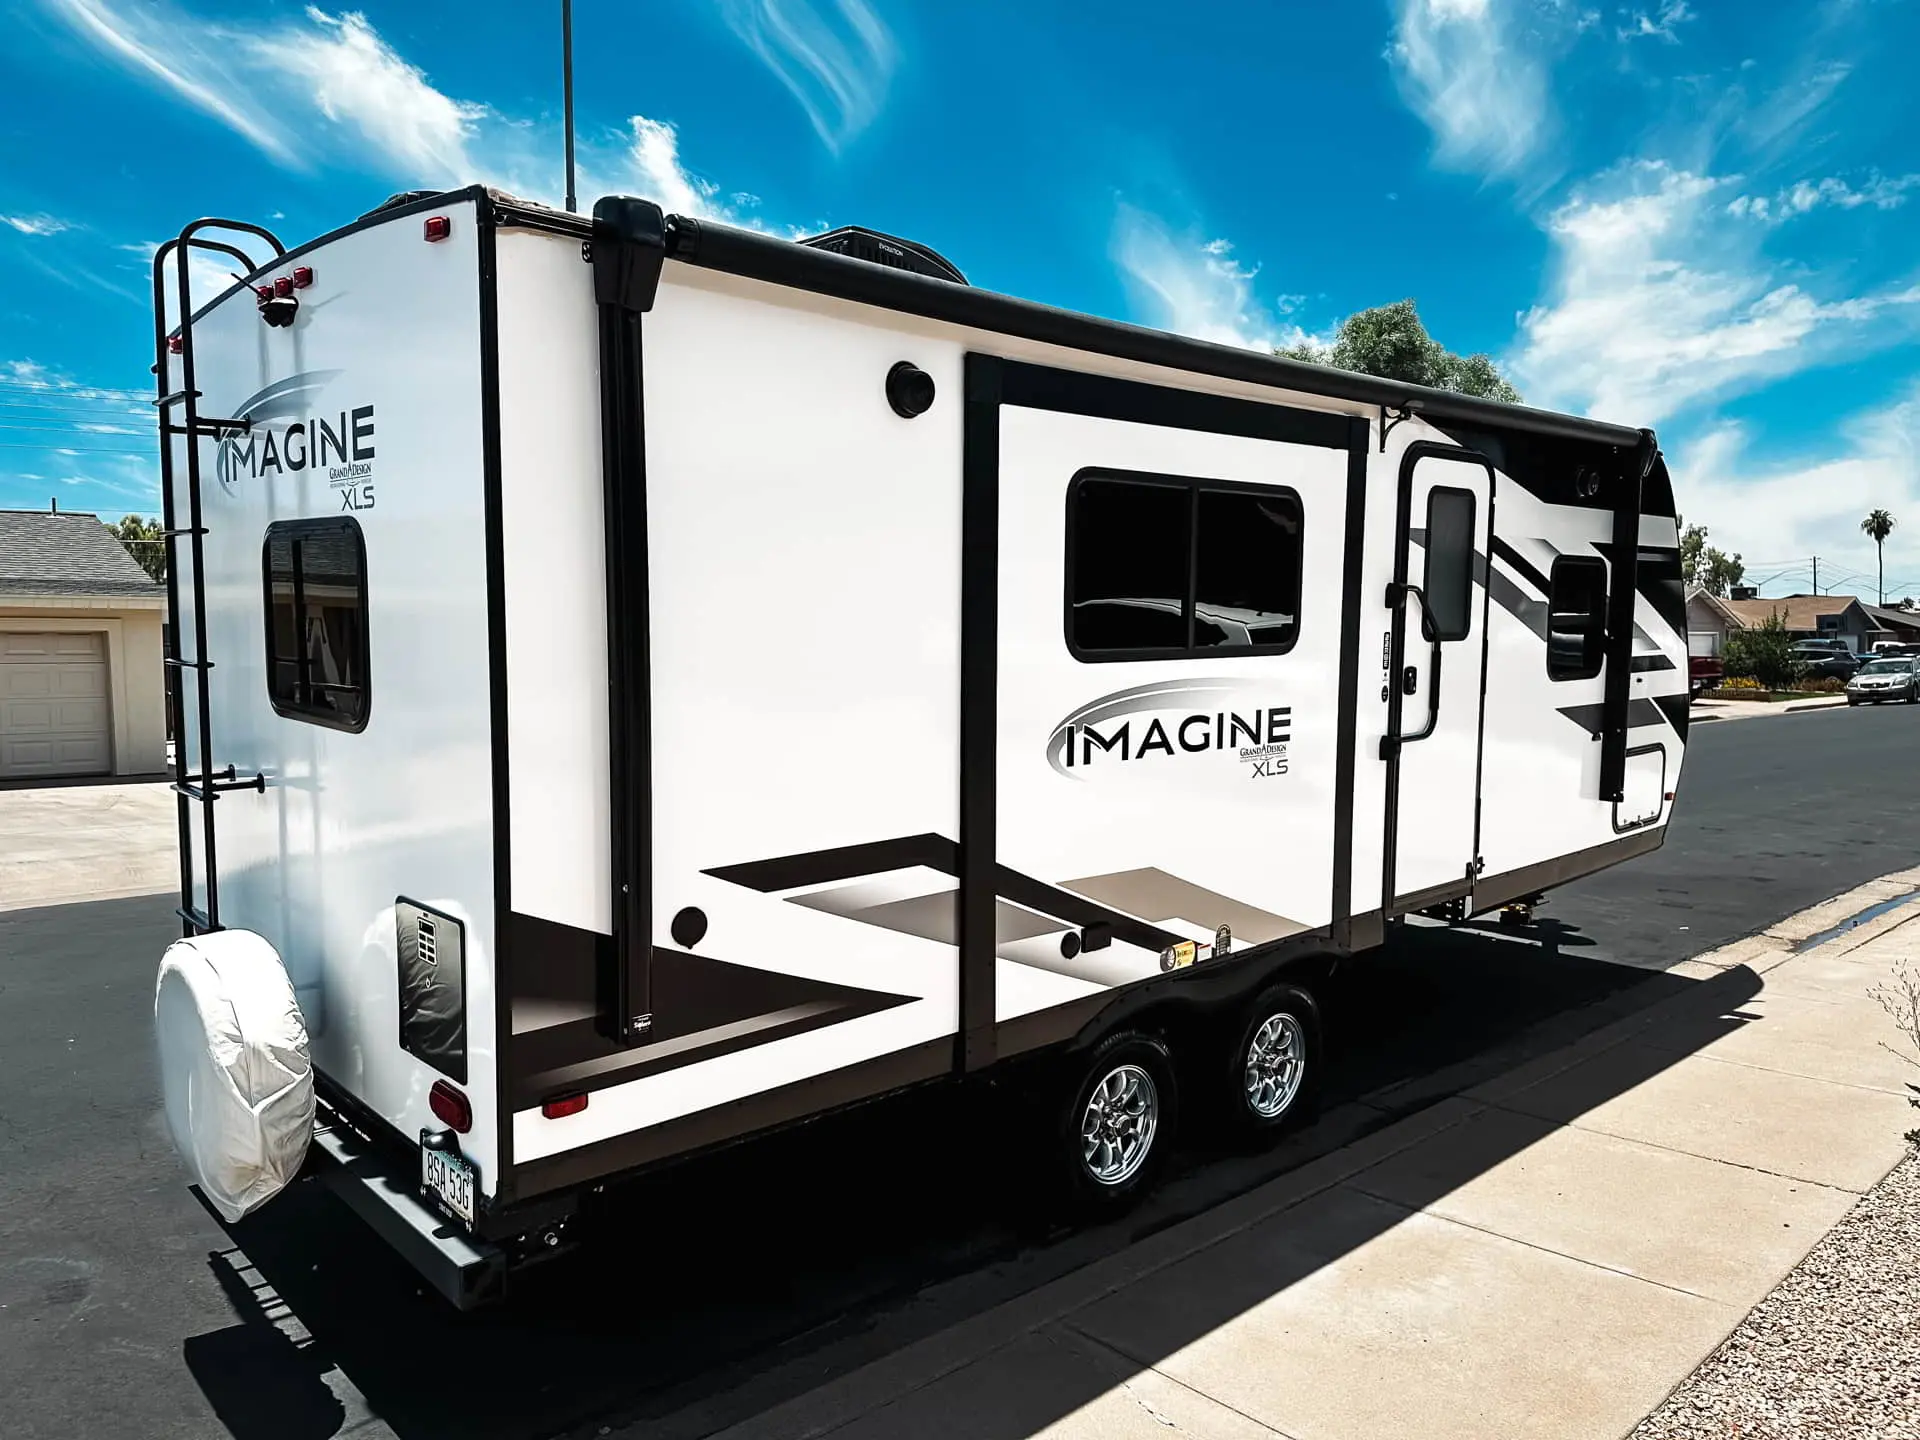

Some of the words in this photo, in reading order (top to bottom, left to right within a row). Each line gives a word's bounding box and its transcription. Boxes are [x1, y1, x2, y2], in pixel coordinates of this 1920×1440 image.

[224, 404, 375, 483] IMAGINE
[341, 486, 375, 511] XLS
[1066, 707, 1291, 767] IMAGINE
[1252, 759, 1289, 779] XLS
[427, 1151, 446, 1194] 8SA
[449, 1167, 469, 1210] 53G
